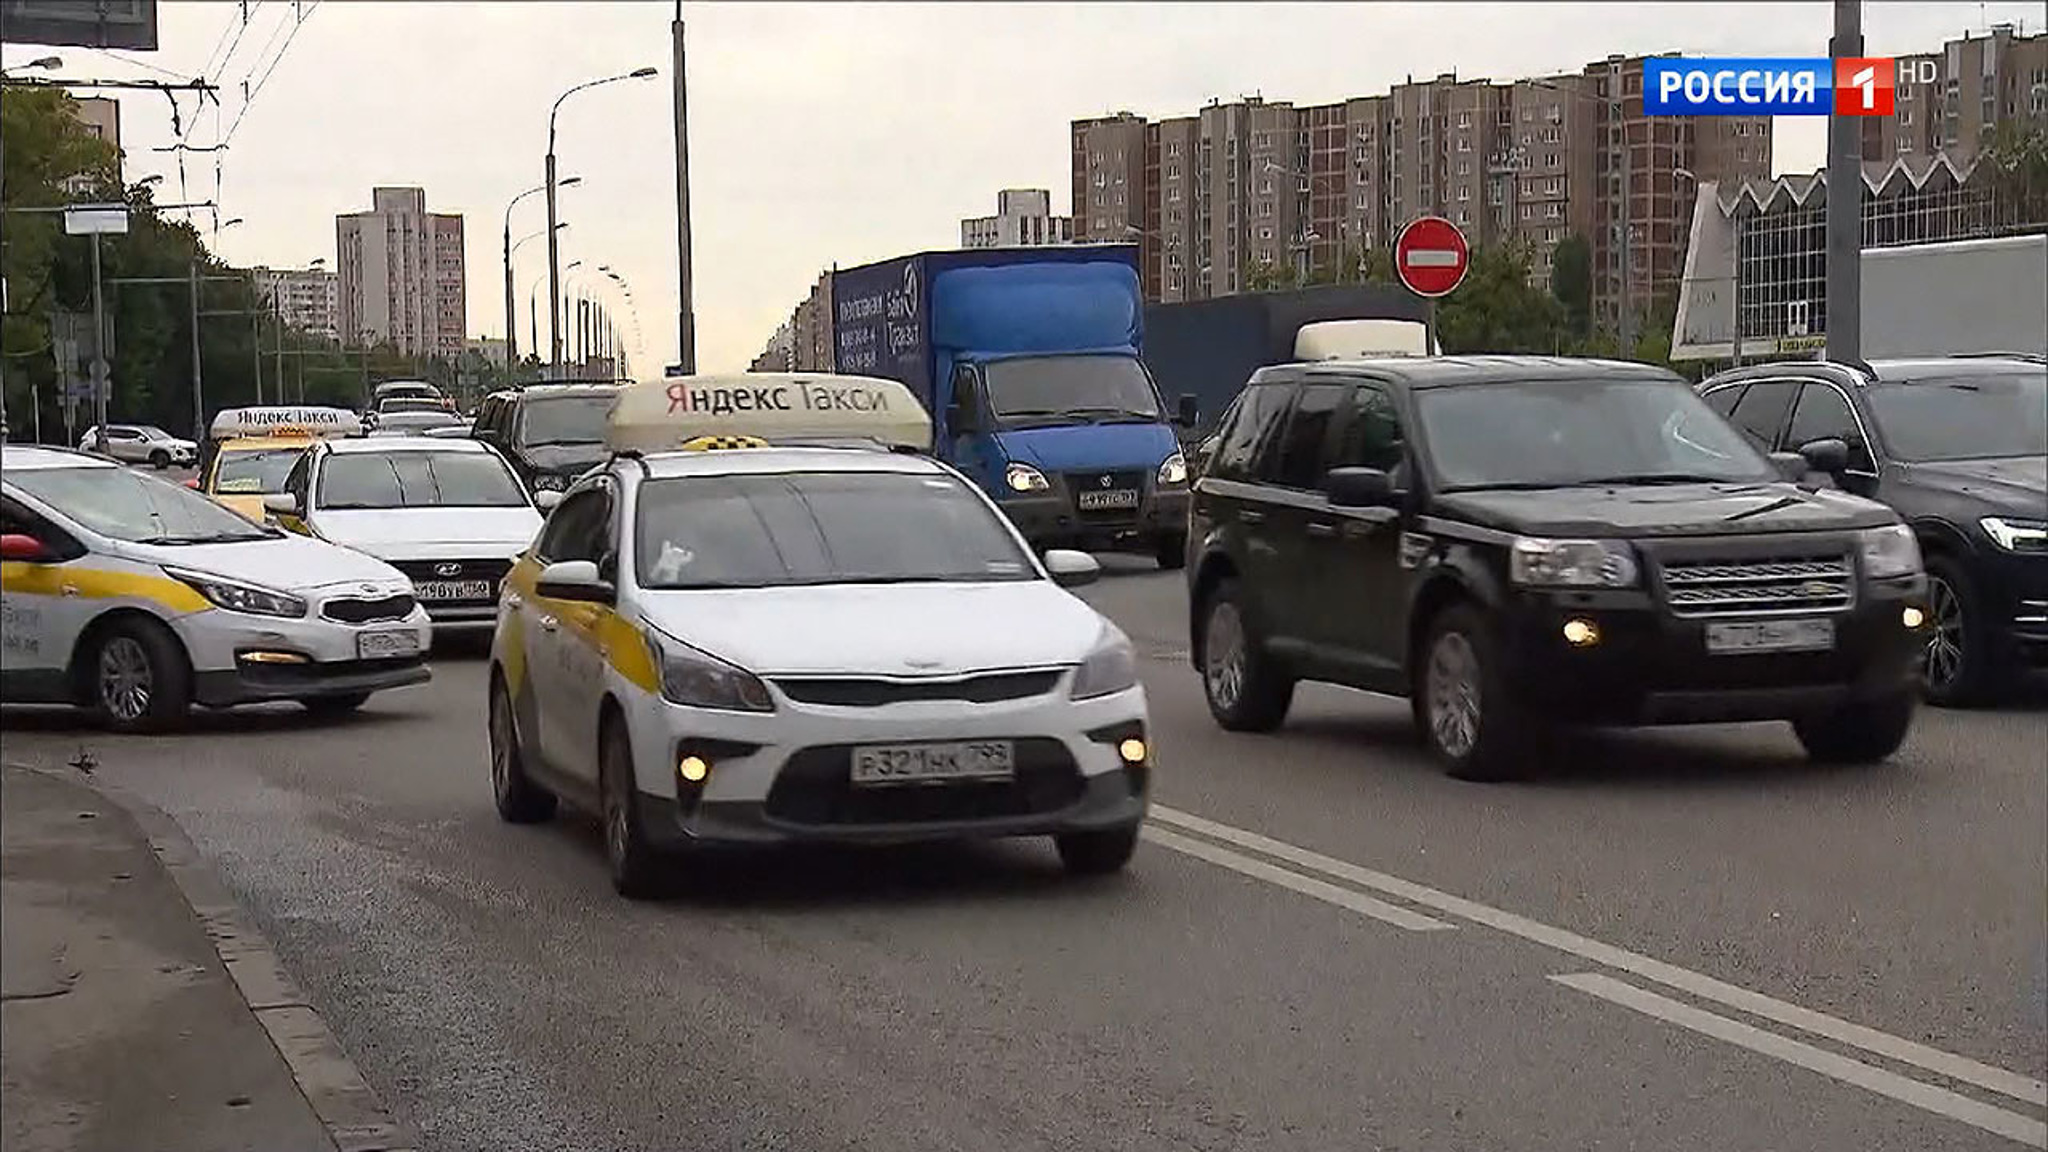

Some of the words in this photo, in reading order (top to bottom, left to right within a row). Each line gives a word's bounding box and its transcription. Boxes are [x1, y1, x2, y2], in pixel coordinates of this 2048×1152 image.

[665, 382, 790, 415] Яндекс
[793, 381, 888, 411] Такси
[238, 410, 293, 424] Яндекс
[298, 410, 338, 423] Такси
